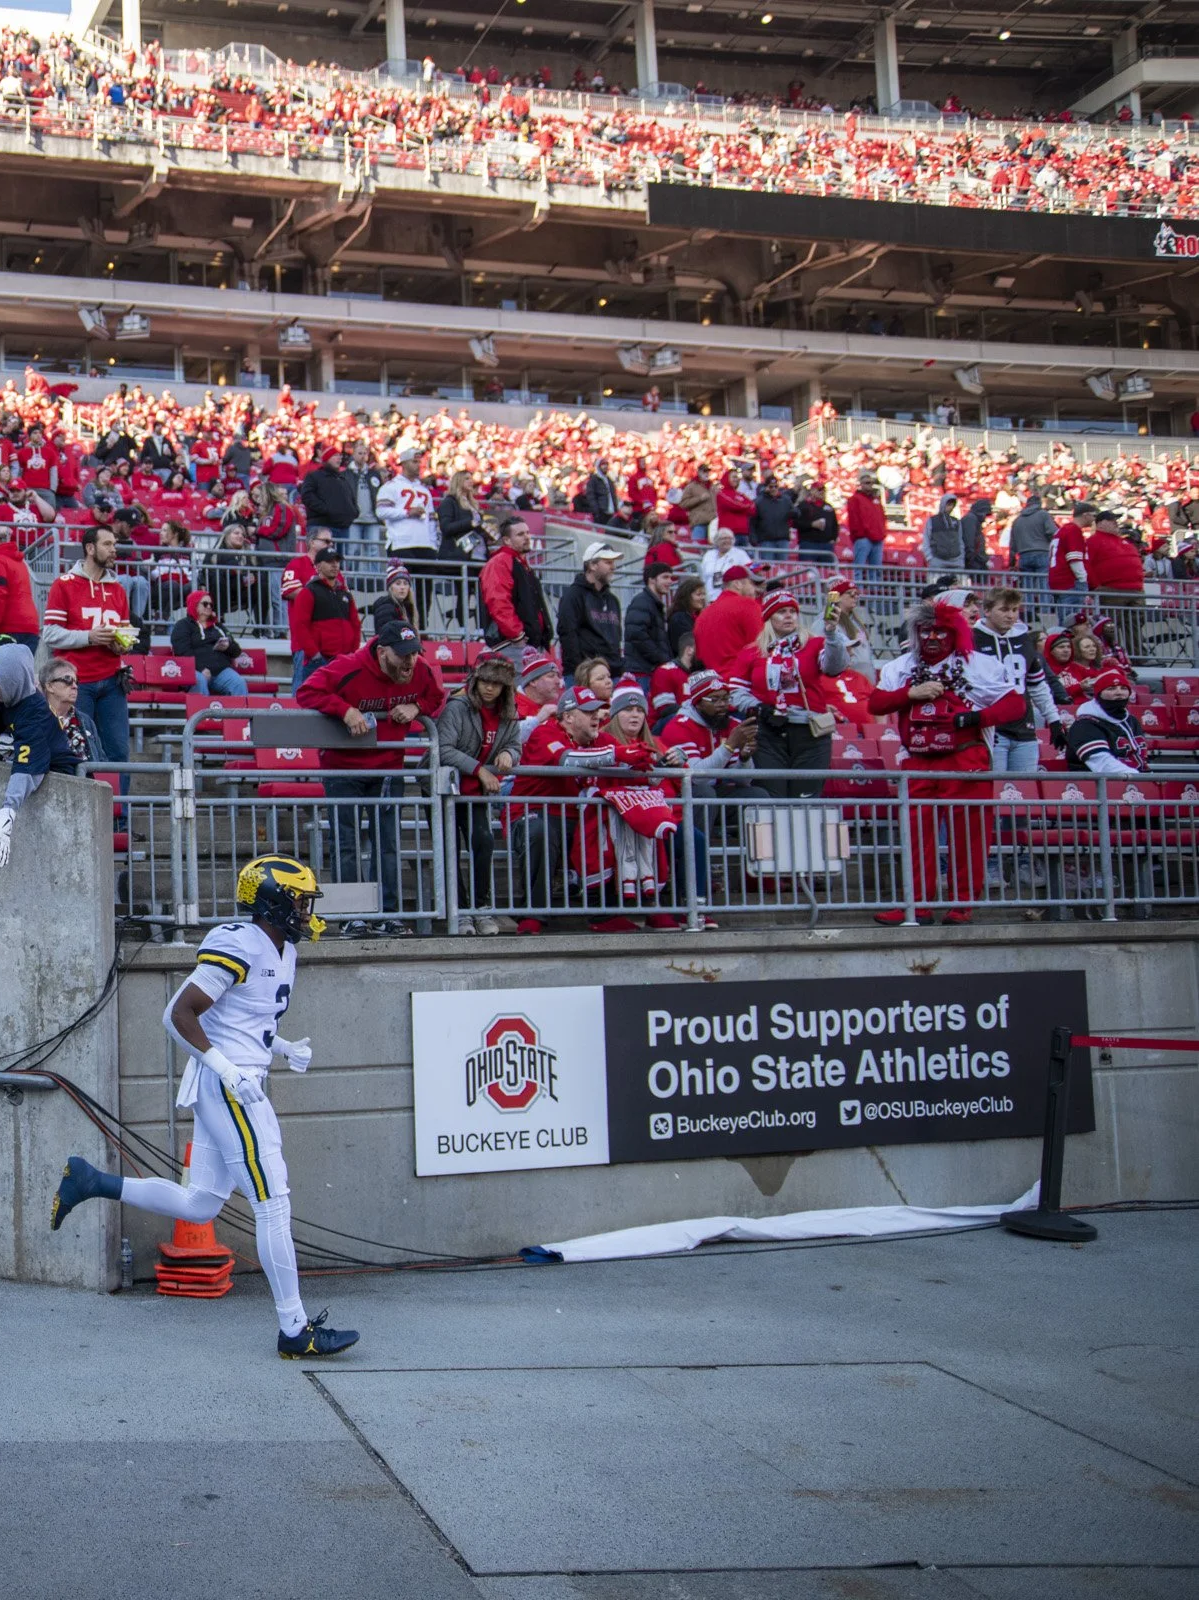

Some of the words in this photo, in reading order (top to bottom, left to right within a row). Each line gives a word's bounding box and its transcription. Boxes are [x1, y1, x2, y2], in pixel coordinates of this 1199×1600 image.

[1176, 235, 1199, 257] RO
[358, 697, 386, 710] OHIO
[18, 745, 30, 763] 2
[648, 1005, 759, 1047] Proud
[770, 1000, 966, 1046] Supporters
[976, 994, 1010, 1030] of
[465, 1047, 504, 1107] OHIO
[505, 1039, 559, 1103] STATE
[648, 1058, 740, 1098] Ohio
[752, 1053, 846, 1092] State
[855, 1044, 1011, 1085] Athletics
[677, 1110, 816, 1134] BuckeyeClub.org
[864, 1096, 1014, 1120] @OSUBuckeyeClub
[437, 1130, 531, 1155] BUCKEYE
[536, 1126, 588, 1148] CLUB
